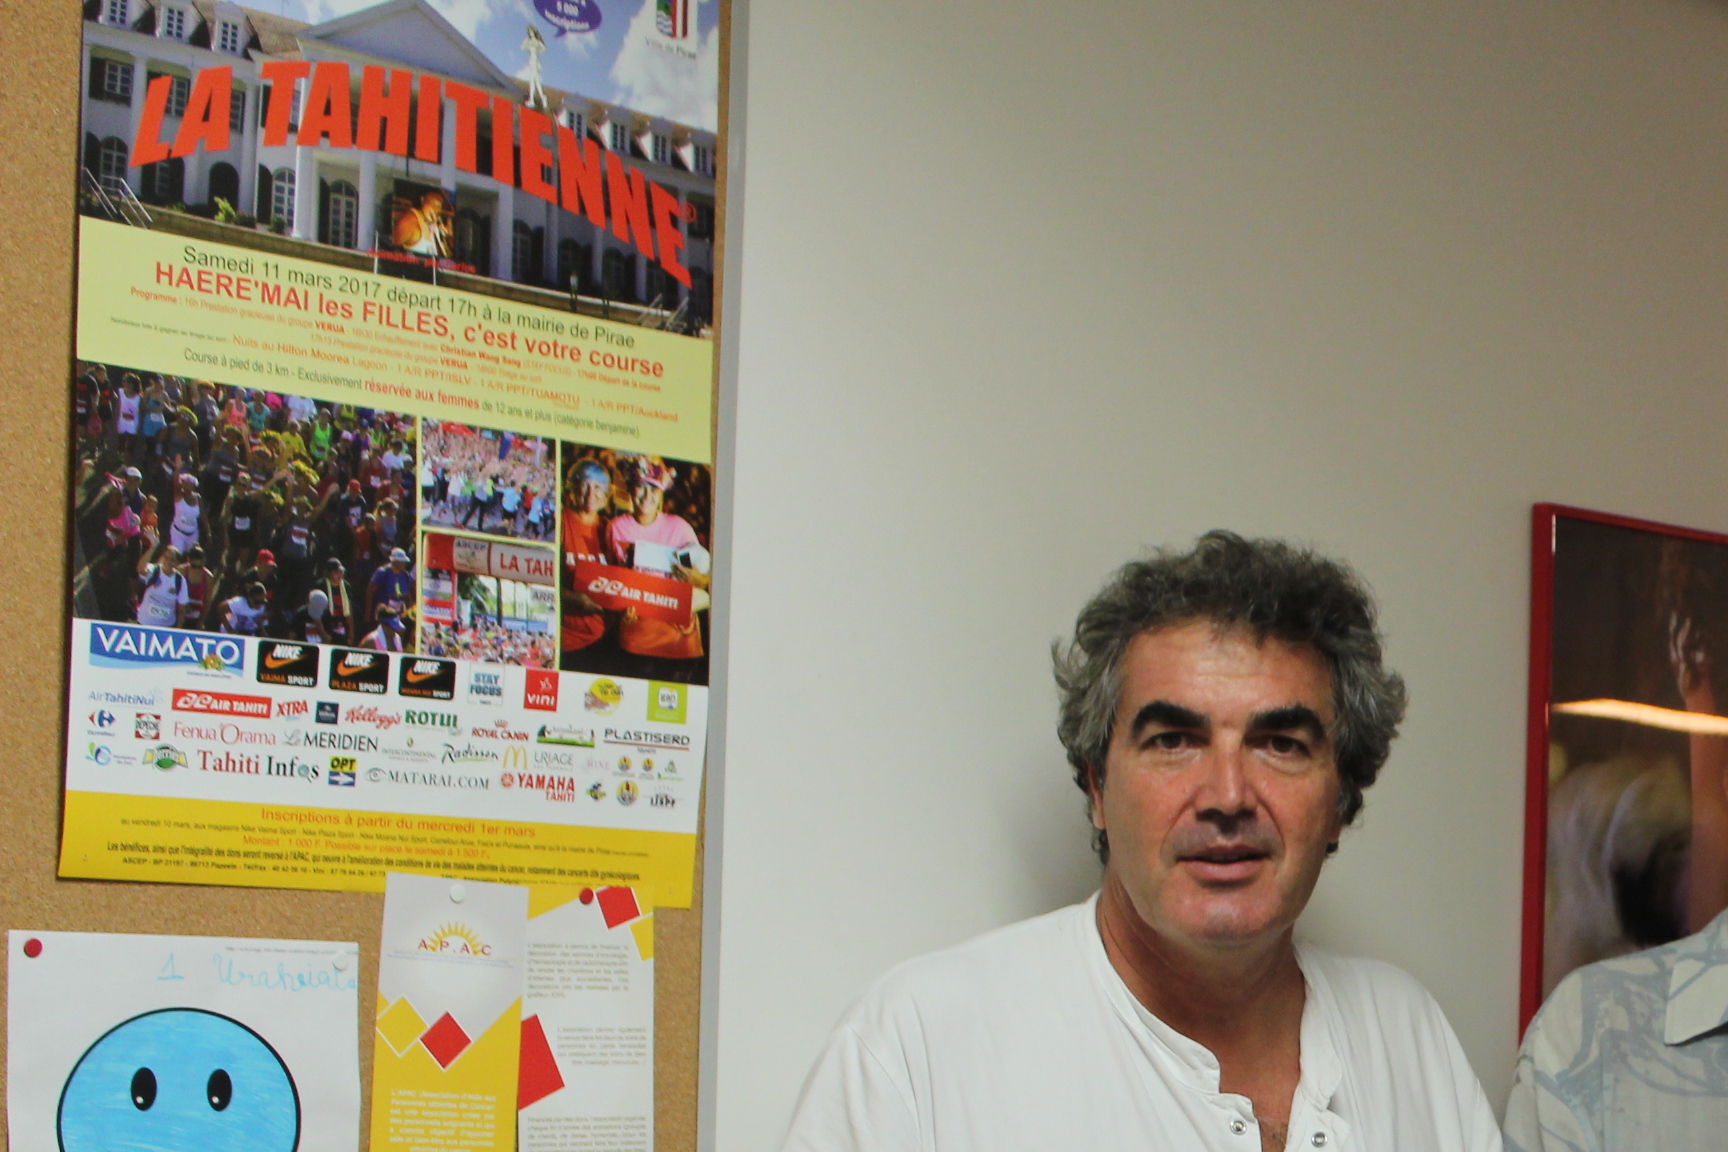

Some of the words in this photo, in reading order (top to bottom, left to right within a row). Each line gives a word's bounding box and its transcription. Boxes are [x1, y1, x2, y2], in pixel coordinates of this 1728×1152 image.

[129, 65, 232, 168] LA
[260, 60, 694, 290] TAHITIENNE
[184, 246, 254, 276] Samedi
[262, 262, 279, 279] 11
[288, 270, 332, 289] mars
[339, 275, 381, 299] 2017
[387, 286, 441, 311] départ
[449, 298, 476, 317] 17h
[483, 304, 492, 321] à
[498, 307, 511, 324] la
[517, 313, 565, 335] mairie
[570, 322, 589, 339] de
[595, 325, 635, 348] Pirae
[156, 261, 309, 311] HAERE'MAI
[319, 292, 353, 319] les
[363, 300, 455, 341] FILLES,
[464, 322, 517, 350] c'est
[525, 337, 582, 362] votre
[589, 350, 664, 378] course
[315, 320, 345, 333] VERUA
[440, 344, 476, 359] Christian
[478, 351, 500, 364] Wang
[277, 342, 307, 358] Hilton
[311, 348, 349, 364] Moorea
[352, 357, 387, 372] Lagoon
[440, 356, 468, 369] VERUA
[184, 347, 218, 365] Course
[221, 355, 227, 367] à
[229, 357, 250, 371] pied
[252, 361, 264, 373] de
[266, 363, 272, 374] 3
[275, 365, 289, 377] km
[298, 368, 362, 390] Exclusivement
[365, 378, 412, 398] réservée
[415, 389, 434, 402] aux
[438, 389, 480, 409] femmes
[482, 401, 492, 411] de
[496, 402, 505, 413] 12
[508, 405, 522, 417] ans
[535, 409, 551, 423] plus
[500, 552, 520, 572] LA
[524, 557, 554, 577] TAH
[621, 587, 642, 600] AIR
[644, 590, 679, 610] TAHITI
[97, 627, 240, 665] VAIMATO
[273, 644, 302, 659] NIKE
[345, 652, 374, 668] NIKE
[413, 659, 441, 674] NIKE
[260, 673, 286, 683] VAIMA
[287, 675, 314, 686] SPORT
[474, 672, 499, 684] STAY
[358, 682, 385, 694] SPORT
[470, 684, 502, 697] FOCUS
[210, 699, 230, 711] AIR
[233, 701, 268, 714] TAHITI
[277, 700, 309, 717] XTRA
[405, 709, 458, 728] ROTUI
[174, 722, 216, 741] Fenua
[471, 727, 499, 739] ROYAL
[501, 731, 529, 741] CANIN
[604, 728, 690, 746] PLASTISERD
[303, 730, 378, 752] MERIDIEN
[197, 750, 260, 775] Tahiti
[331, 757, 356, 770] OPT
[534, 751, 574, 766] URIAGE
[518, 773, 575, 792] YAMAHA
[546, 791, 575, 803] TAHITI
[261, 808, 340, 825] Inscriptions
[344, 813, 353, 825] à
[357, 816, 392, 829] partir
[396, 818, 413, 829] du
[417, 820, 475, 834] mercredi
[481, 823, 500, 835] 1er
[504, 825, 536, 837] mars
